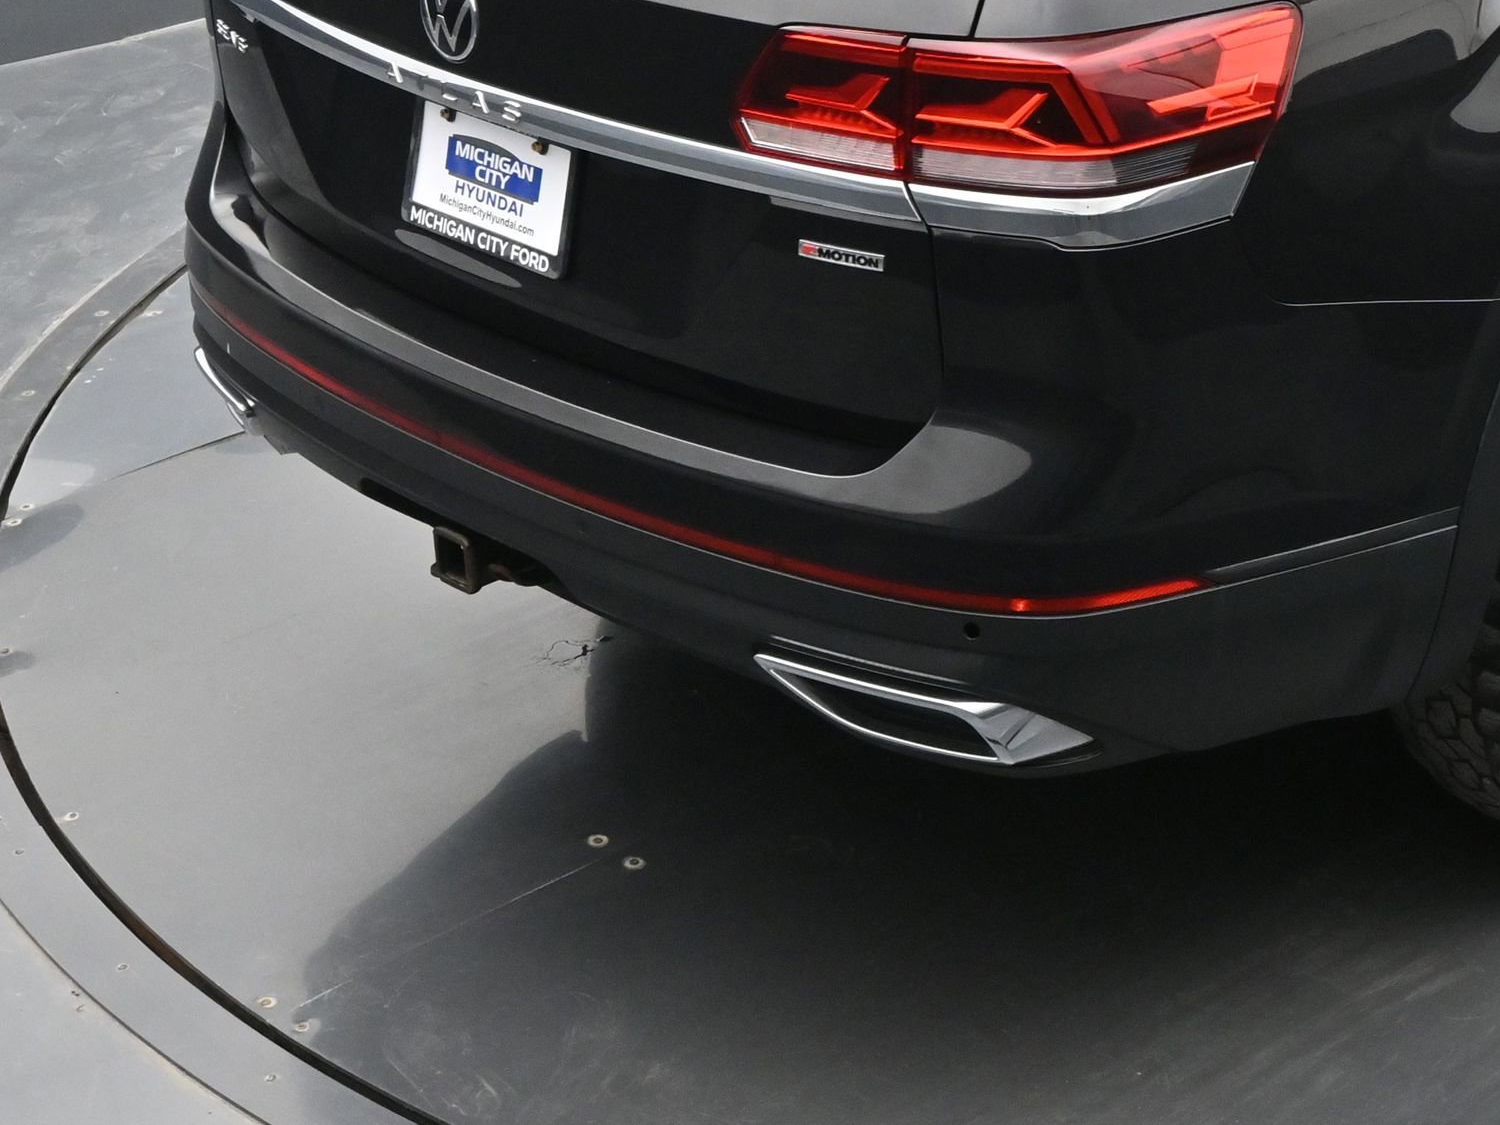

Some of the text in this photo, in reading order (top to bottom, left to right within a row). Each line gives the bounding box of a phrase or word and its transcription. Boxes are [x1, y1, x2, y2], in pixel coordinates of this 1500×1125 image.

[386, 61, 520, 122] ATLAS
[455, 140, 534, 183] MICHIGAN
[474, 166, 512, 190] CITY
[439, 192, 535, 237] MichiganCityHyundai.com
[454, 180, 524, 218] HYUNDAI
[410, 205, 550, 273] MICHIGAN CITY FORD
